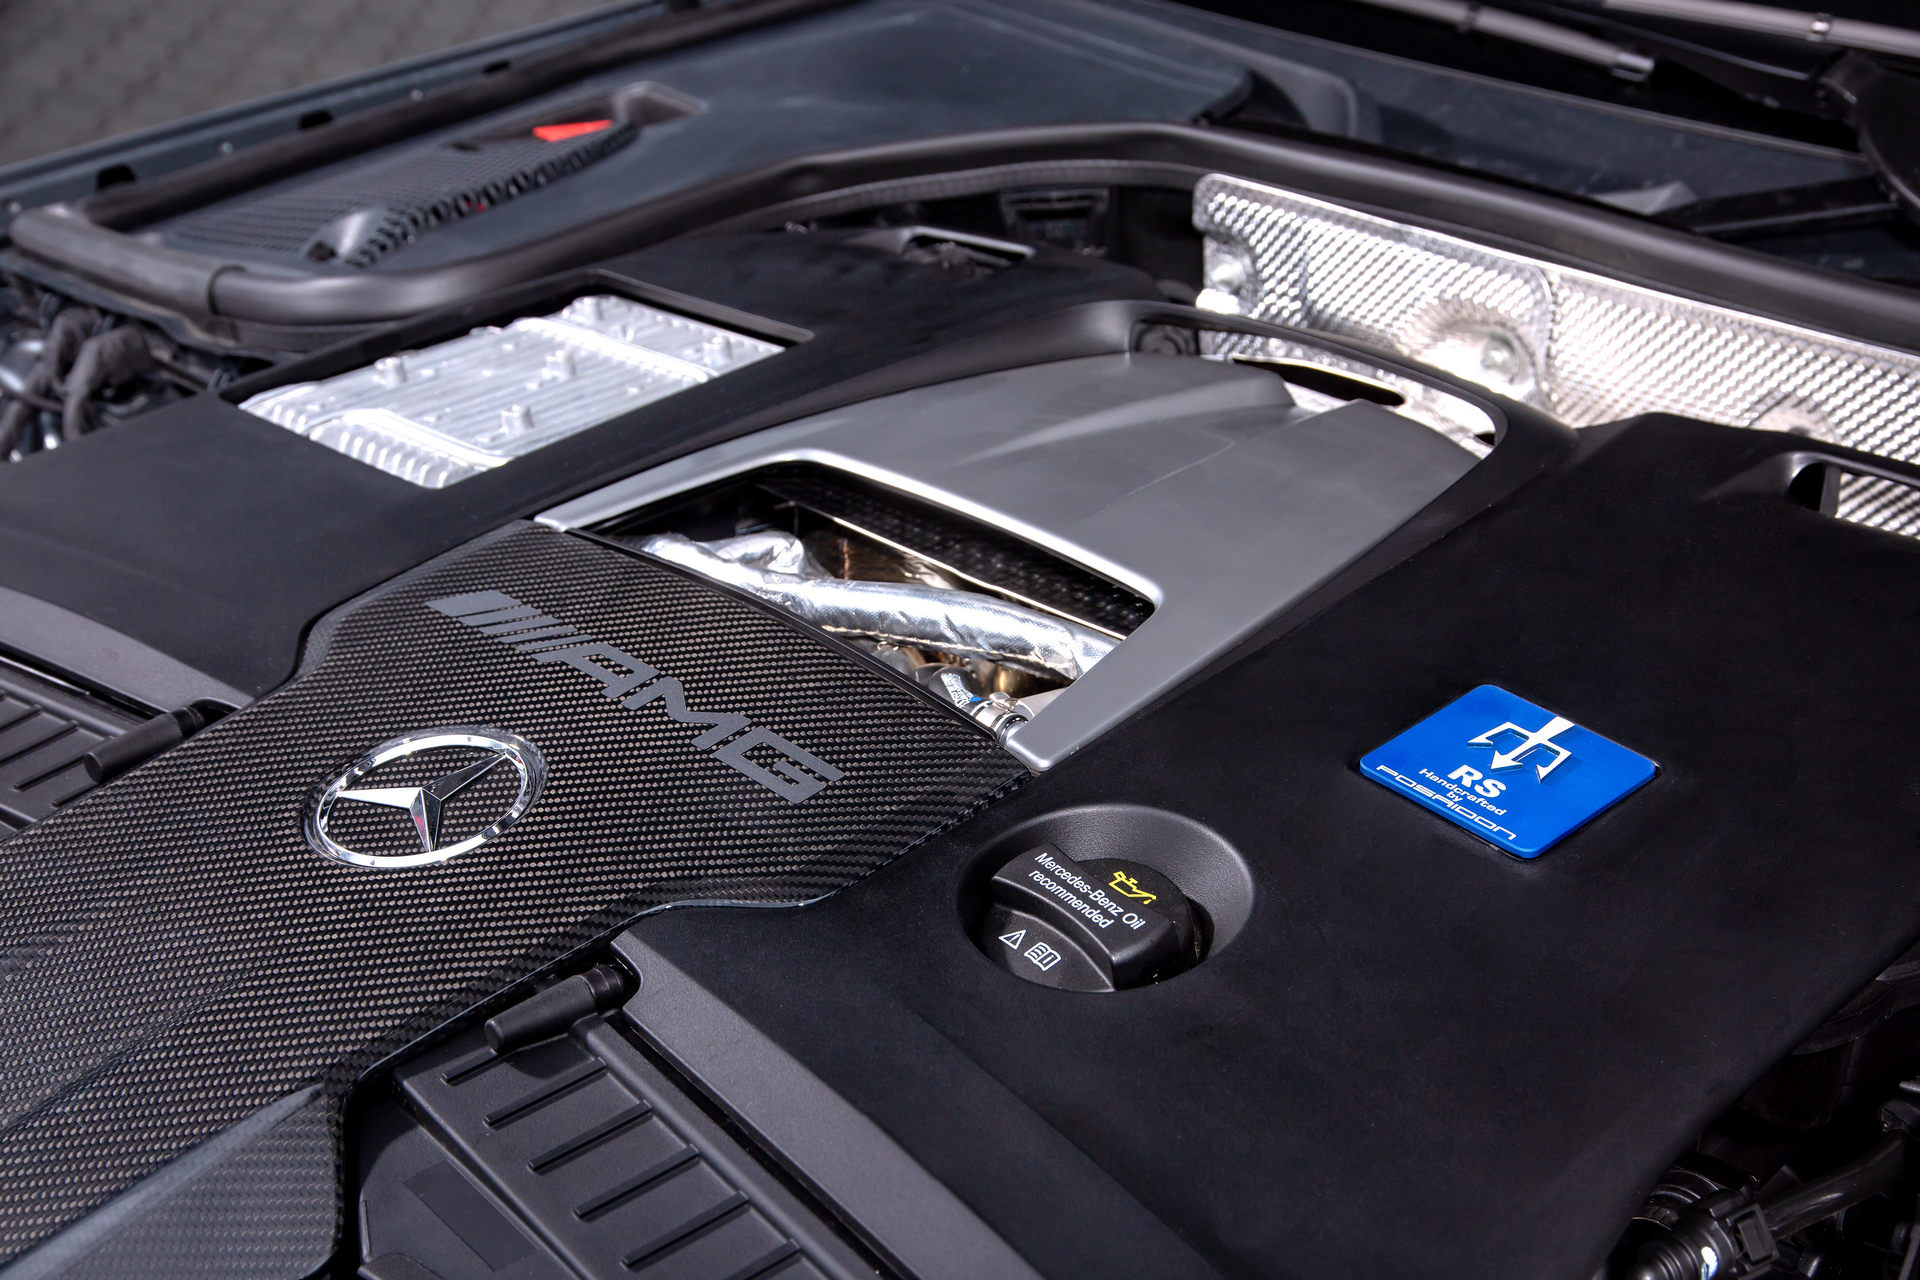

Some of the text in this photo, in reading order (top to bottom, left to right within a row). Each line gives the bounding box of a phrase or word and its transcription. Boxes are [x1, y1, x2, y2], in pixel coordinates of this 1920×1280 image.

[533, 643, 845, 804] AMG
[1376, 764, 1517, 841] POSAIDON
[1418, 768, 1508, 816] Handcrafted
[1445, 790, 1464, 802] by
[1447, 764, 1507, 798] RS
[1028, 870, 1114, 929] recommended
[1034, 852, 1146, 930] Mercedes-Benz Oil
